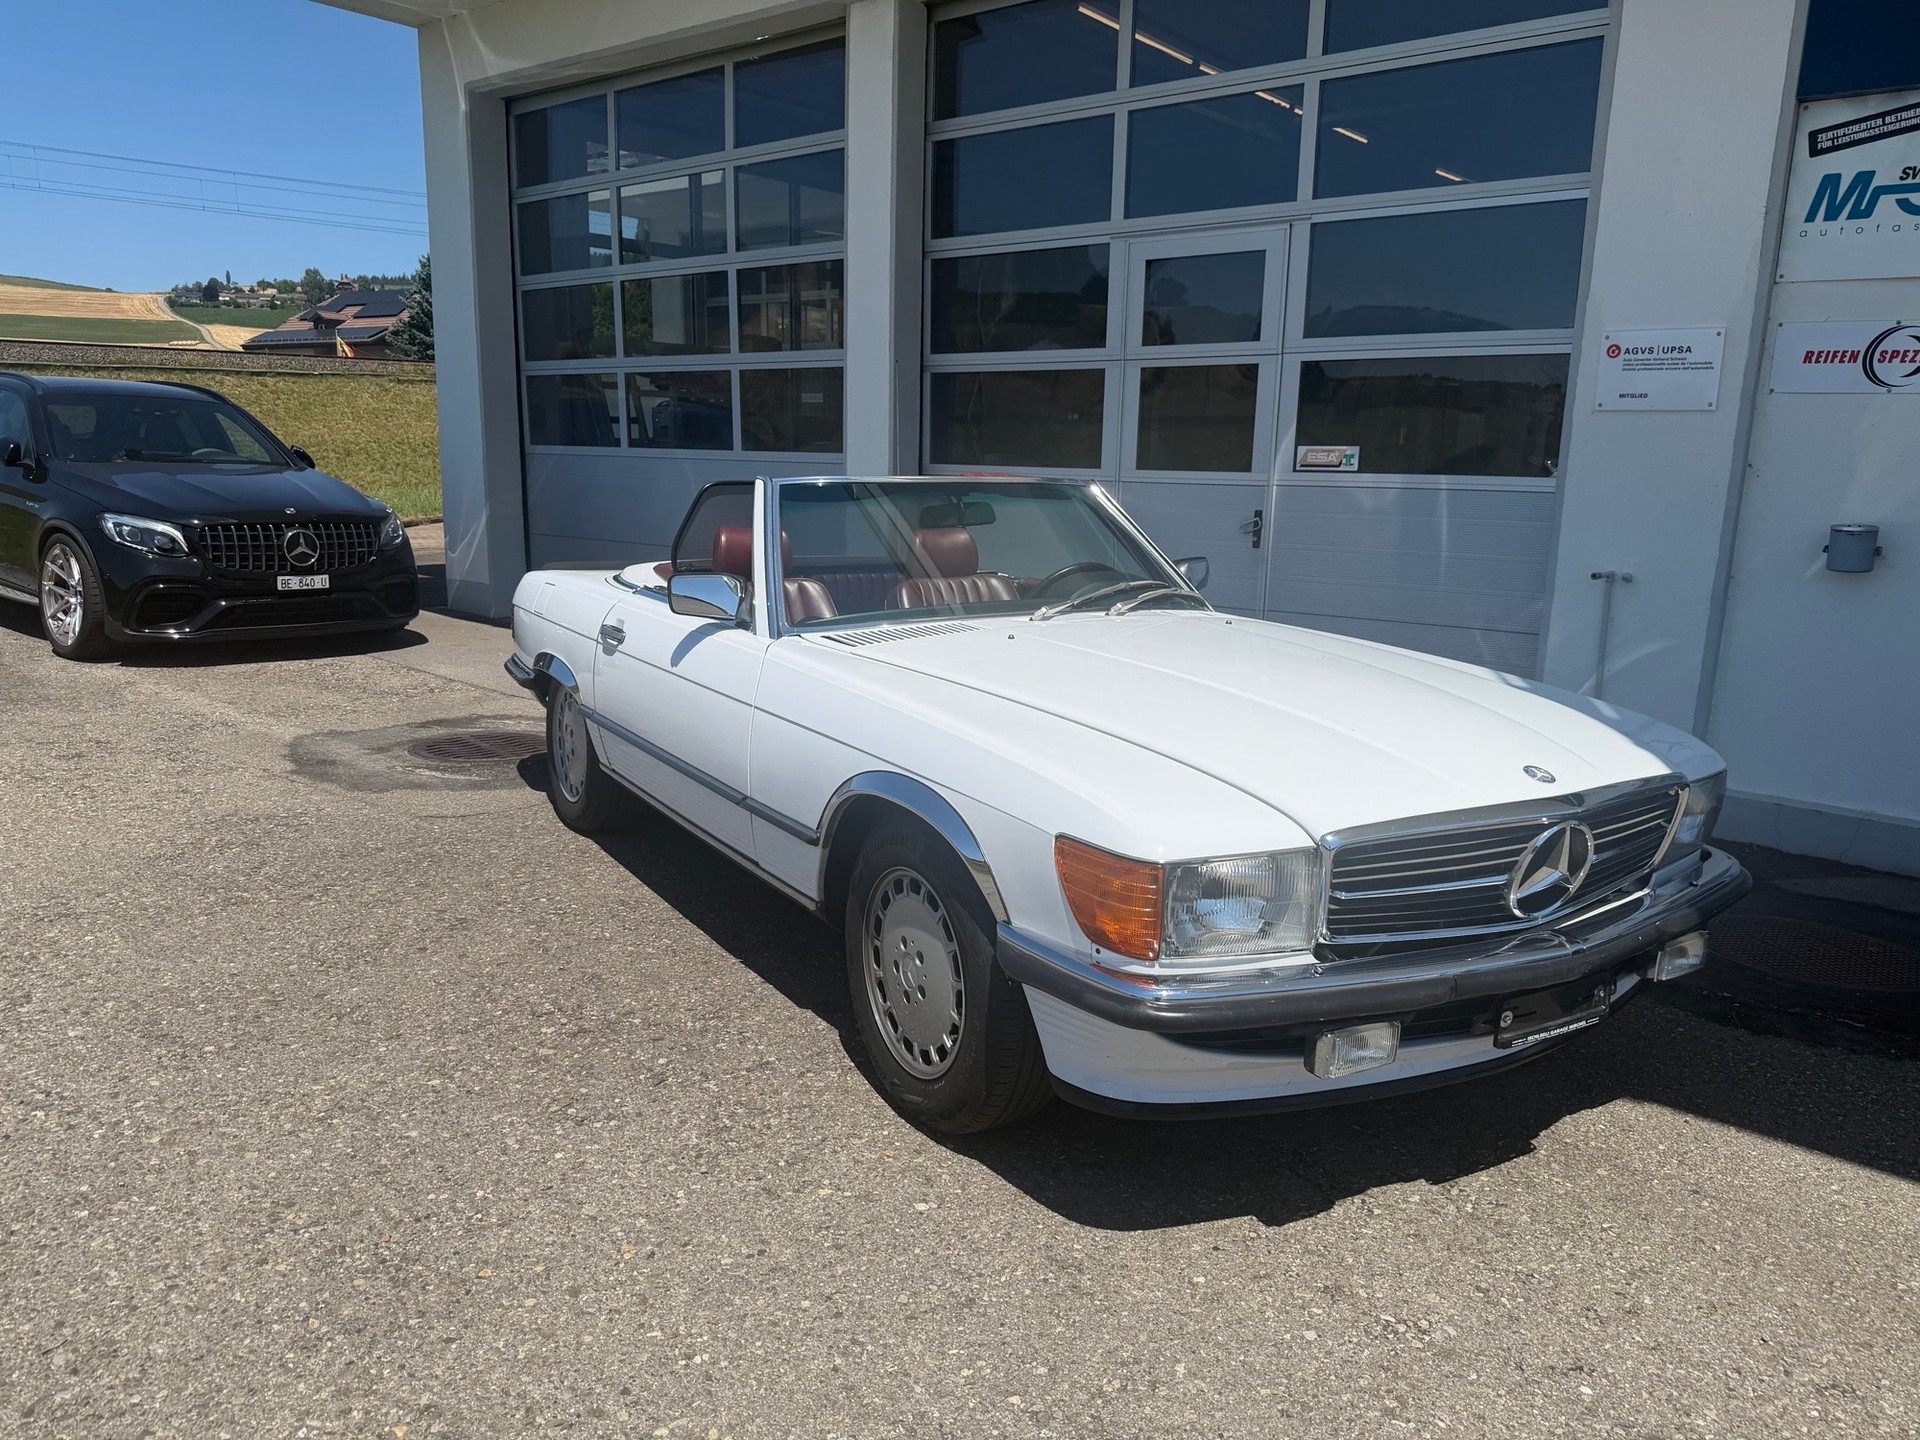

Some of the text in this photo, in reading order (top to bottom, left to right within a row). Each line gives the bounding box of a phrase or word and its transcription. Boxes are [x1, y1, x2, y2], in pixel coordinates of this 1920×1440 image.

[1817, 118, 1883, 142] ZERTIFIZIERTER
[1817, 140, 1833, 150] FÜR
[1623, 345, 1692, 355] AGVS UPSA
[1802, 349, 1920, 364] REIFEN SPEZ
